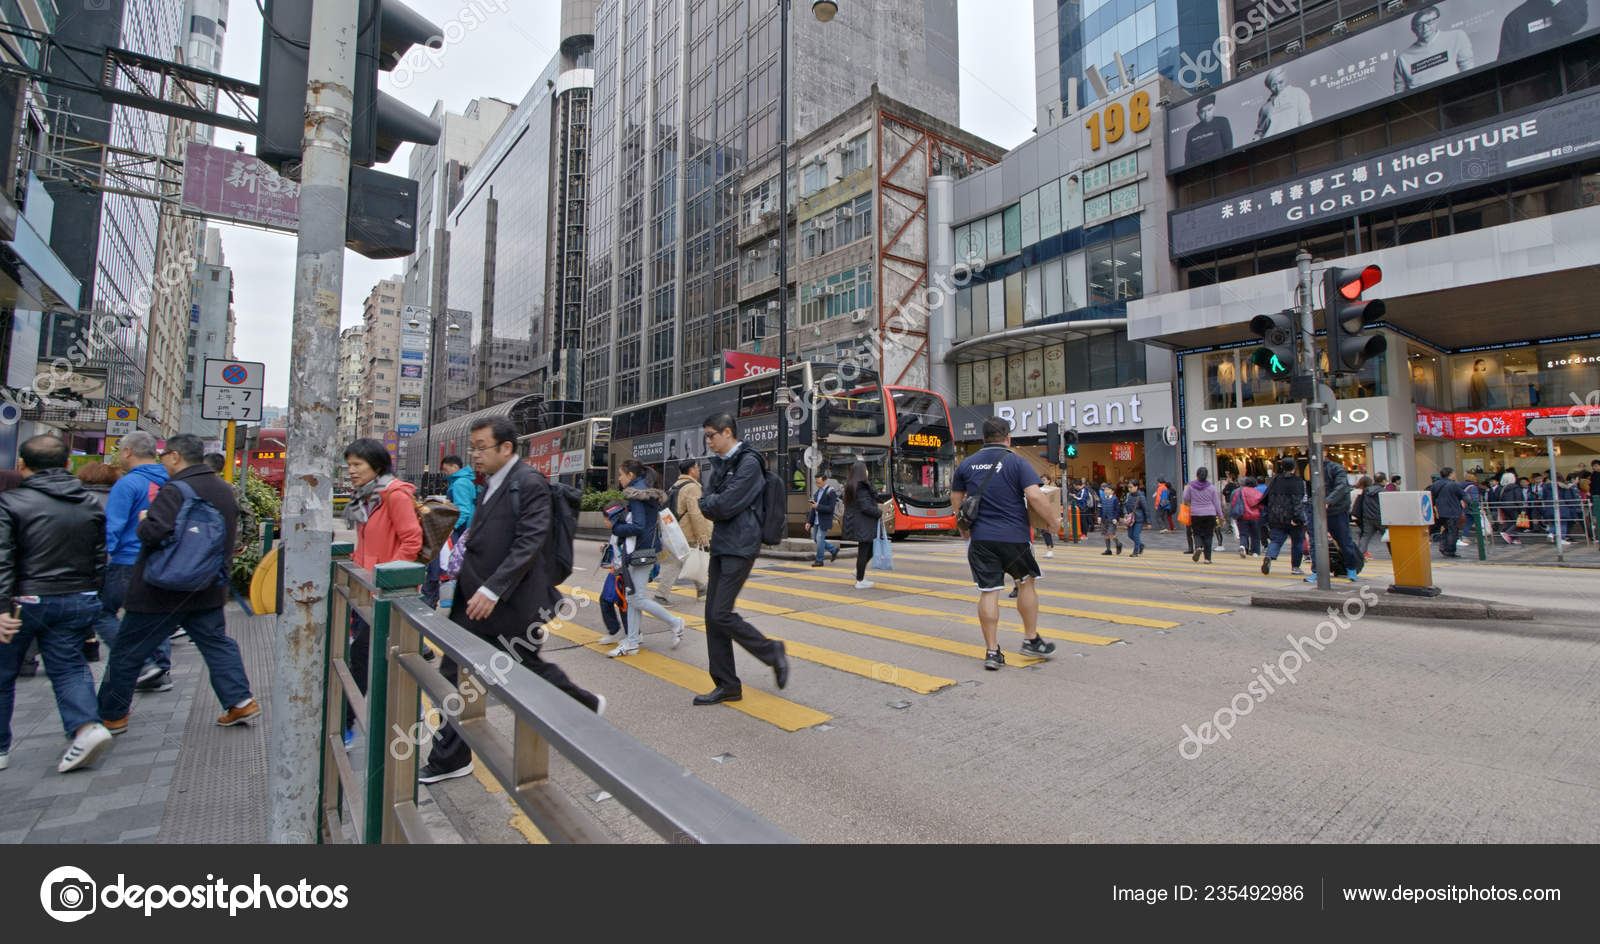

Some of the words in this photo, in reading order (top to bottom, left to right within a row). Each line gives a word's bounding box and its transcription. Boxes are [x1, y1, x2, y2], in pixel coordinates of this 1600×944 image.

[1326, 66, 1376, 88] theFUTURE
[1085, 90, 1151, 151] 198
[1392, 119, 1538, 172] theFUTURE
[1286, 171, 1444, 221] GIORDANO
[242, 391, 252, 401] 7
[241, 407, 251, 418] 7
[998, 393, 1143, 432] Brilliant
[1201, 408, 1370, 433] GIORDNO
[744, 428, 793, 442] GIORDAO
[1493, 426, 1512, 435] off
[632, 447, 664, 458] GIORDANO
